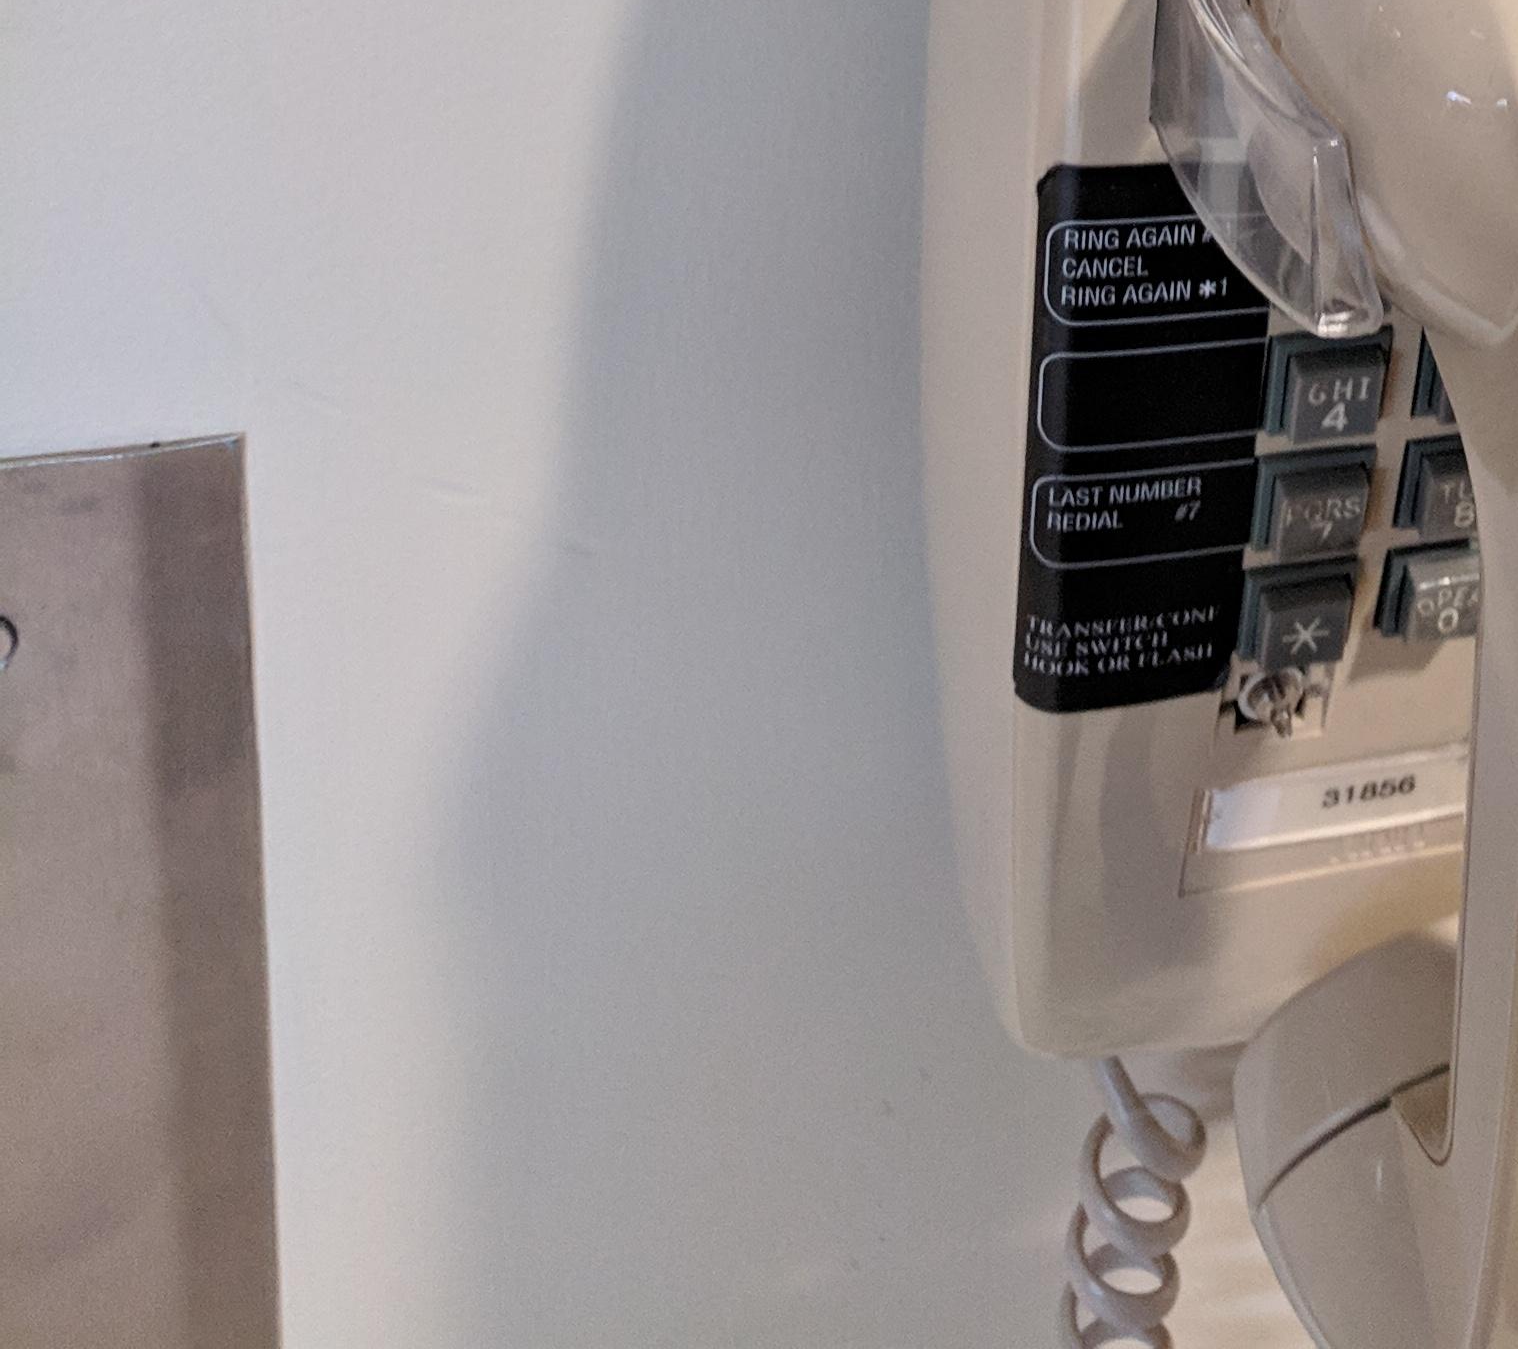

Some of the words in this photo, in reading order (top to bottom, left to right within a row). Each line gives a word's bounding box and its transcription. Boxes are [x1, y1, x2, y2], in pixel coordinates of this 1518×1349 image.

[1063, 228, 1120, 251] RING
[1126, 224, 1196, 250] AGAIN
[1062, 255, 1149, 279] CANCEL
[1060, 284, 1116, 307] RING
[1122, 279, 1192, 305] AGAIN
[1308, 376, 1371, 406] GHI
[1321, 403, 1348, 432] 4
[1048, 486, 1103, 508] LAST
[1109, 476, 1202, 504] NUMBER
[1047, 509, 1123, 533] REDIAL
[1454, 501, 1475, 528] 8
[1322, 774, 1416, 809] 31856
